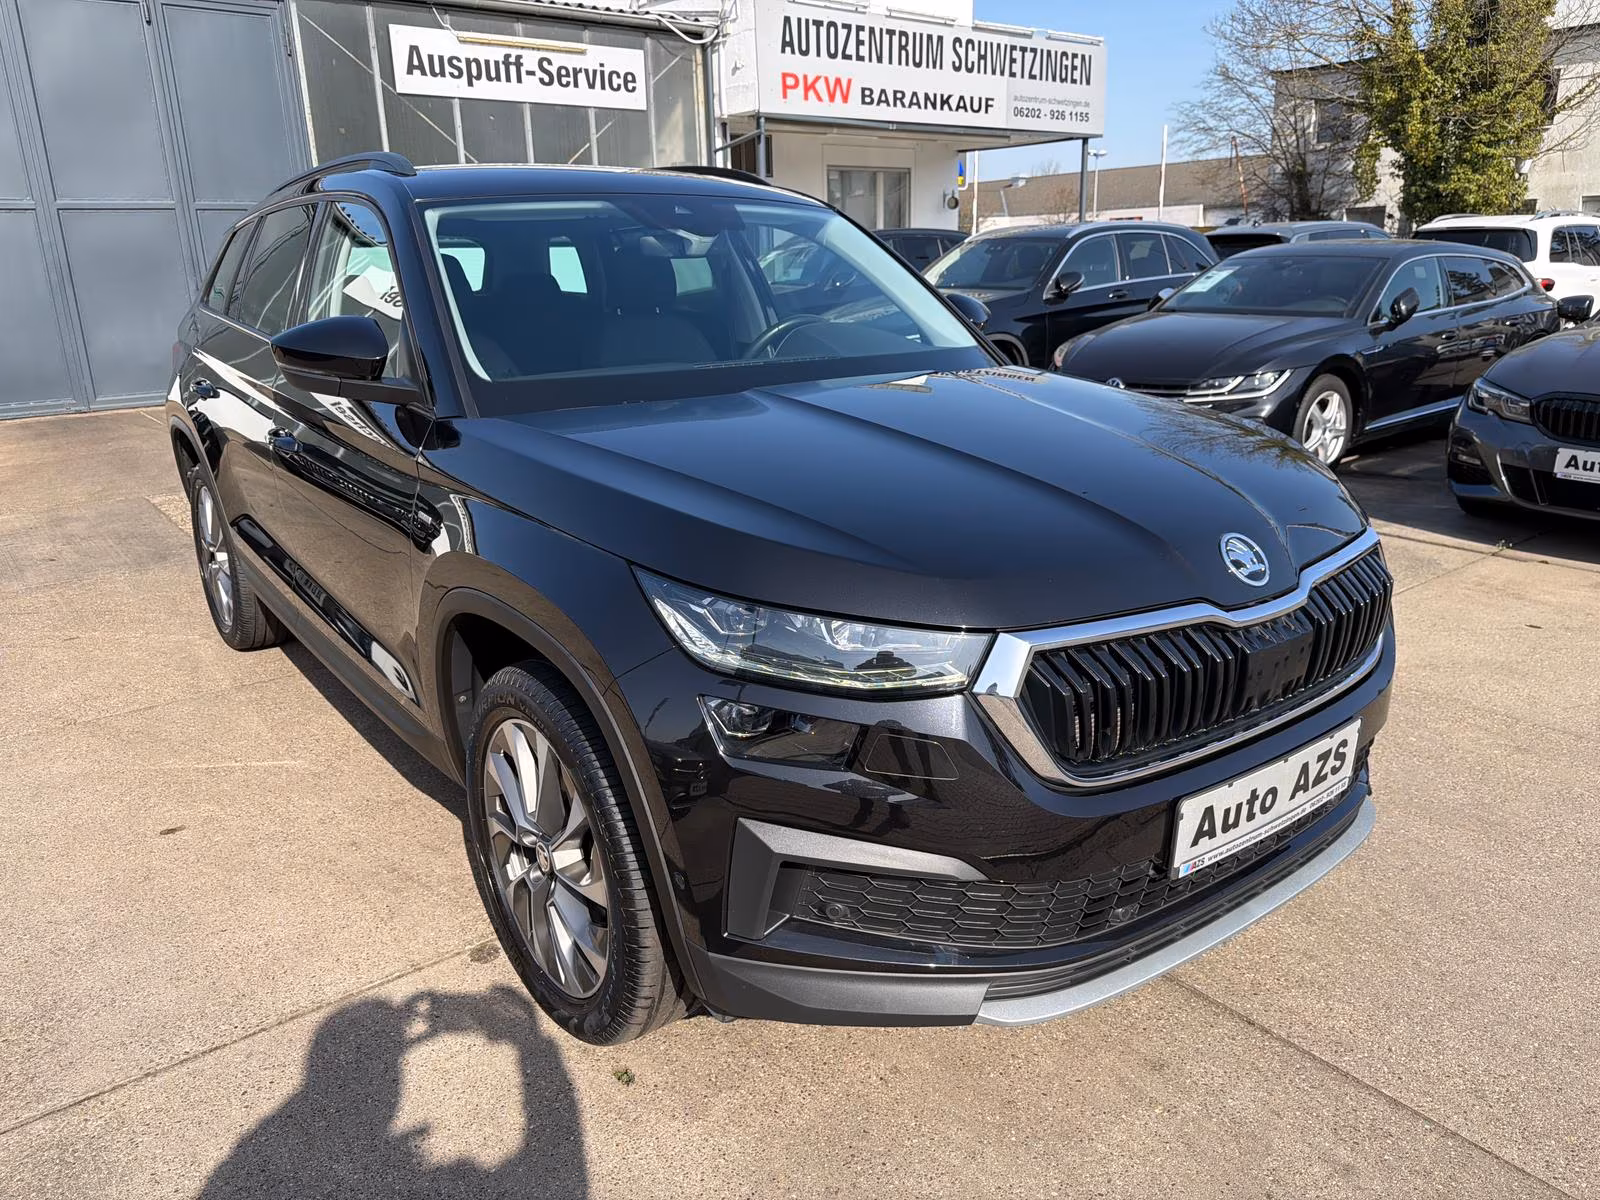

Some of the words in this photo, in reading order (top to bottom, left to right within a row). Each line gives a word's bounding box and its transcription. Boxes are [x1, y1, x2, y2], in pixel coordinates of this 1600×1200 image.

[406, 45, 637, 93] Auspuff-Service
[780, 15, 944, 71] AUTOZENTRUM
[952, 37, 1092, 86] SCHWETZINGEN
[780, 72, 853, 104] PKW
[860, 86, 995, 115] BARANKAUF
[1013, 106, 1042, 119] 06202
[1049, 109, 1066, 121] 926
[1069, 111, 1090, 123] 1155
[1189, 786, 1278, 849] Auto
[1289, 738, 1348, 801] AZS
